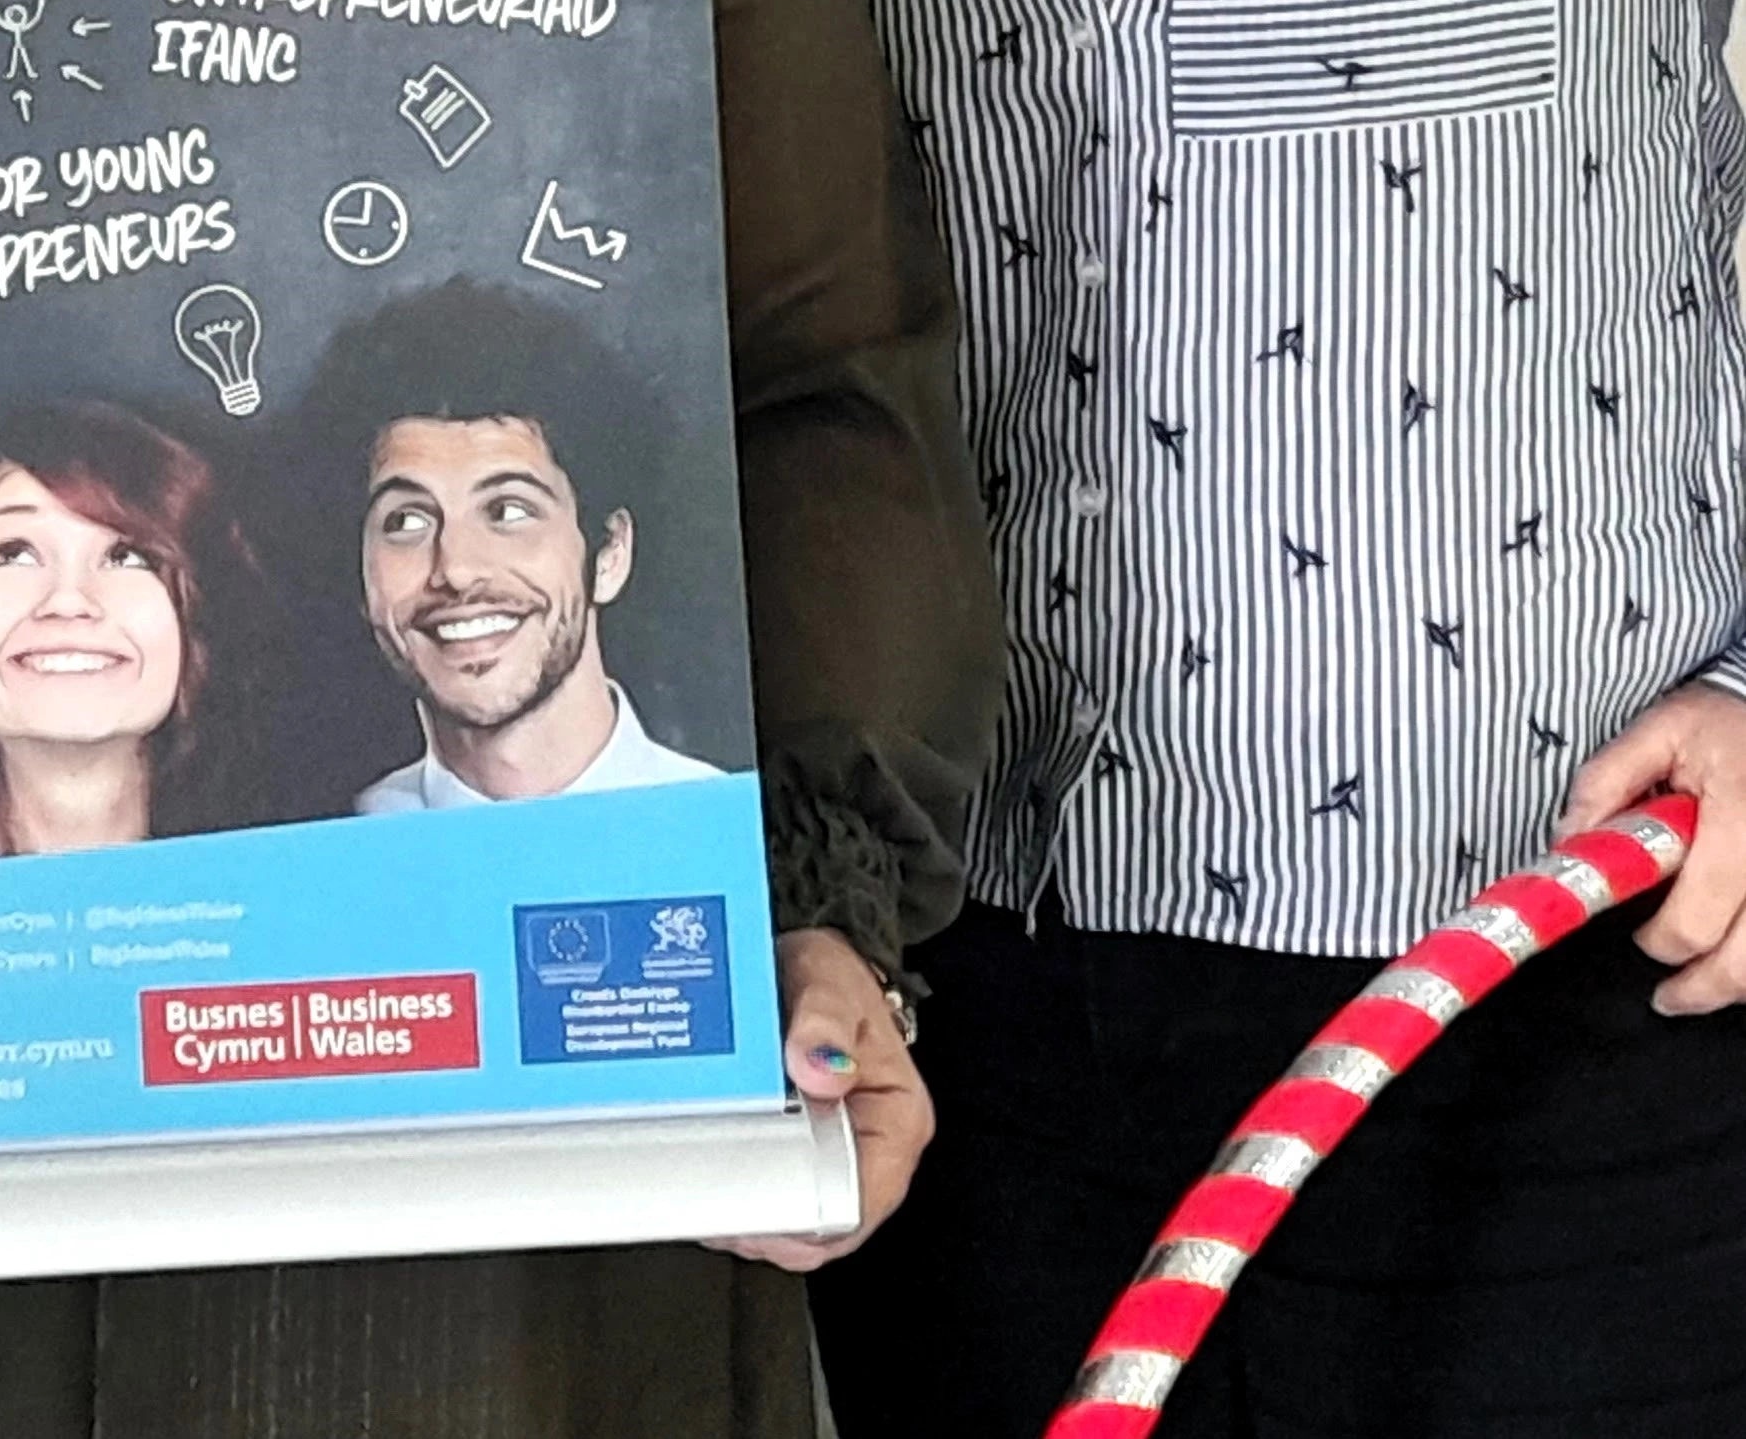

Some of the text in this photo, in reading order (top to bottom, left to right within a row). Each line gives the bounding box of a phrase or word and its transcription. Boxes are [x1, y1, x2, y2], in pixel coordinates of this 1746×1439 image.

[152, 21, 298, 84] IFANC
[60, 128, 215, 207] YOUNG
[165, 989, 452, 1033] Busnes Business
[174, 1023, 412, 1073] Cymru Wales
